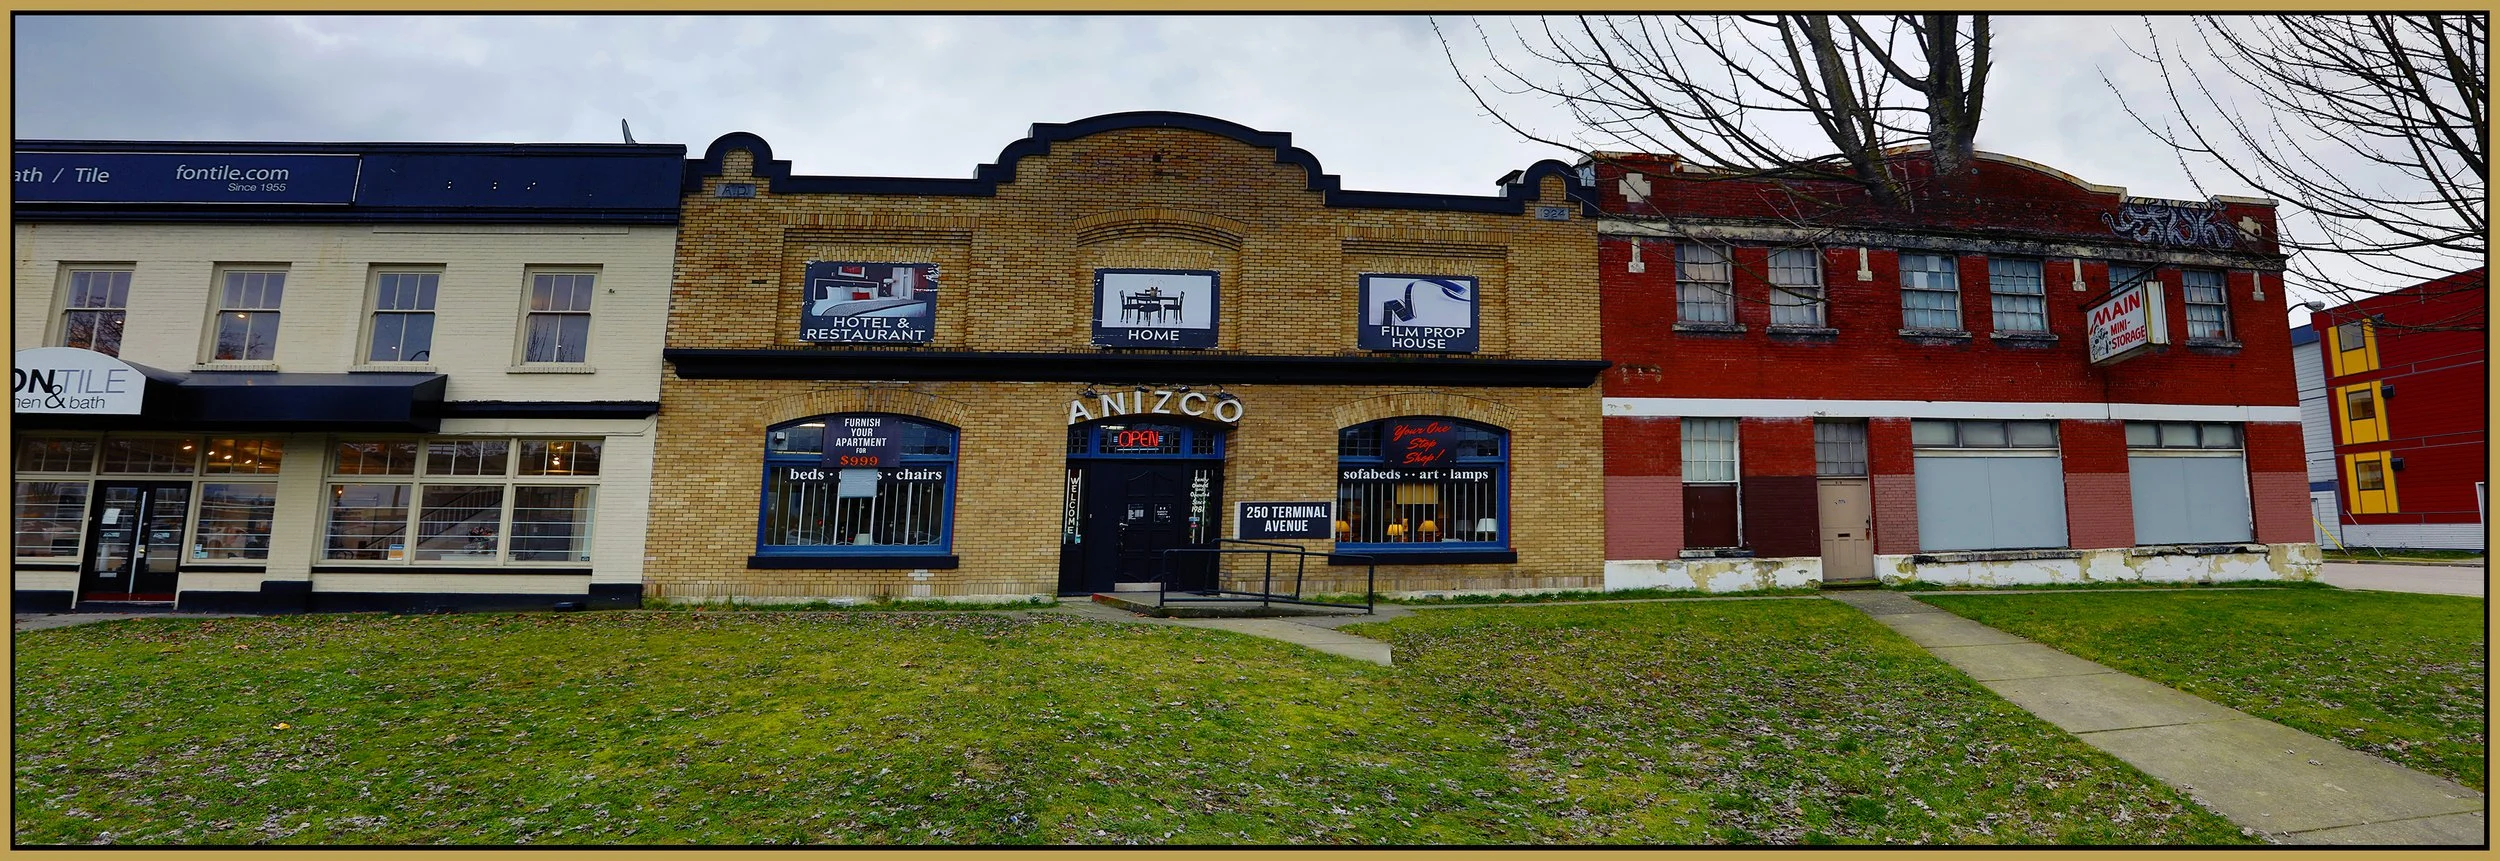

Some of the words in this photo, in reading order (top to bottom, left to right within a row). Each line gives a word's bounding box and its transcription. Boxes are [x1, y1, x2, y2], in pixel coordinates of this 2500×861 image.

[75, 167, 110, 183] Tile
[176, 164, 289, 181] fontile.com
[228, 182, 257, 192] Since
[260, 183, 287, 192] 1955
[2089, 291, 2140, 335] MAIN
[833, 317, 891, 328] HOTEL
[897, 317, 909, 329] &
[2110, 319, 2131, 336] MINI-
[806, 328, 926, 340] RESTAURANT
[1128, 329, 1180, 341] HOME
[1381, 326, 1419, 337] FILM
[1424, 327, 1466, 338] PROP
[2112, 325, 2145, 349] STORAGE
[1392, 337, 1446, 349] HOUSE
[44, 384, 66, 409] &
[69, 396, 105, 409] bath
[1068, 390, 1244, 425] ANIZCO
[844, 418, 881, 427] FURNISH
[850, 428, 873, 437] YOUR
[1392, 425, 1425, 442] Your
[1426, 422, 1452, 434] One
[835, 438, 887, 447] APARTMENT
[1118, 431, 1159, 447] OPEN
[1407, 438, 1437, 452] Stop
[839, 455, 879, 466] $999
[1402, 449, 1446, 467] Shop!
[790, 469, 825, 480] beds
[896, 469, 942, 480] chairs
[1343, 469, 1401, 480] sofabeds
[1419, 470, 1440, 480] art
[1450, 469, 1489, 482] lamps
[1067, 477, 1080, 534] WELCOME
[1246, 506, 1268, 519] 250
[1272, 506, 1328, 518] TERMINAL
[1264, 520, 1309, 532] AVENUE
